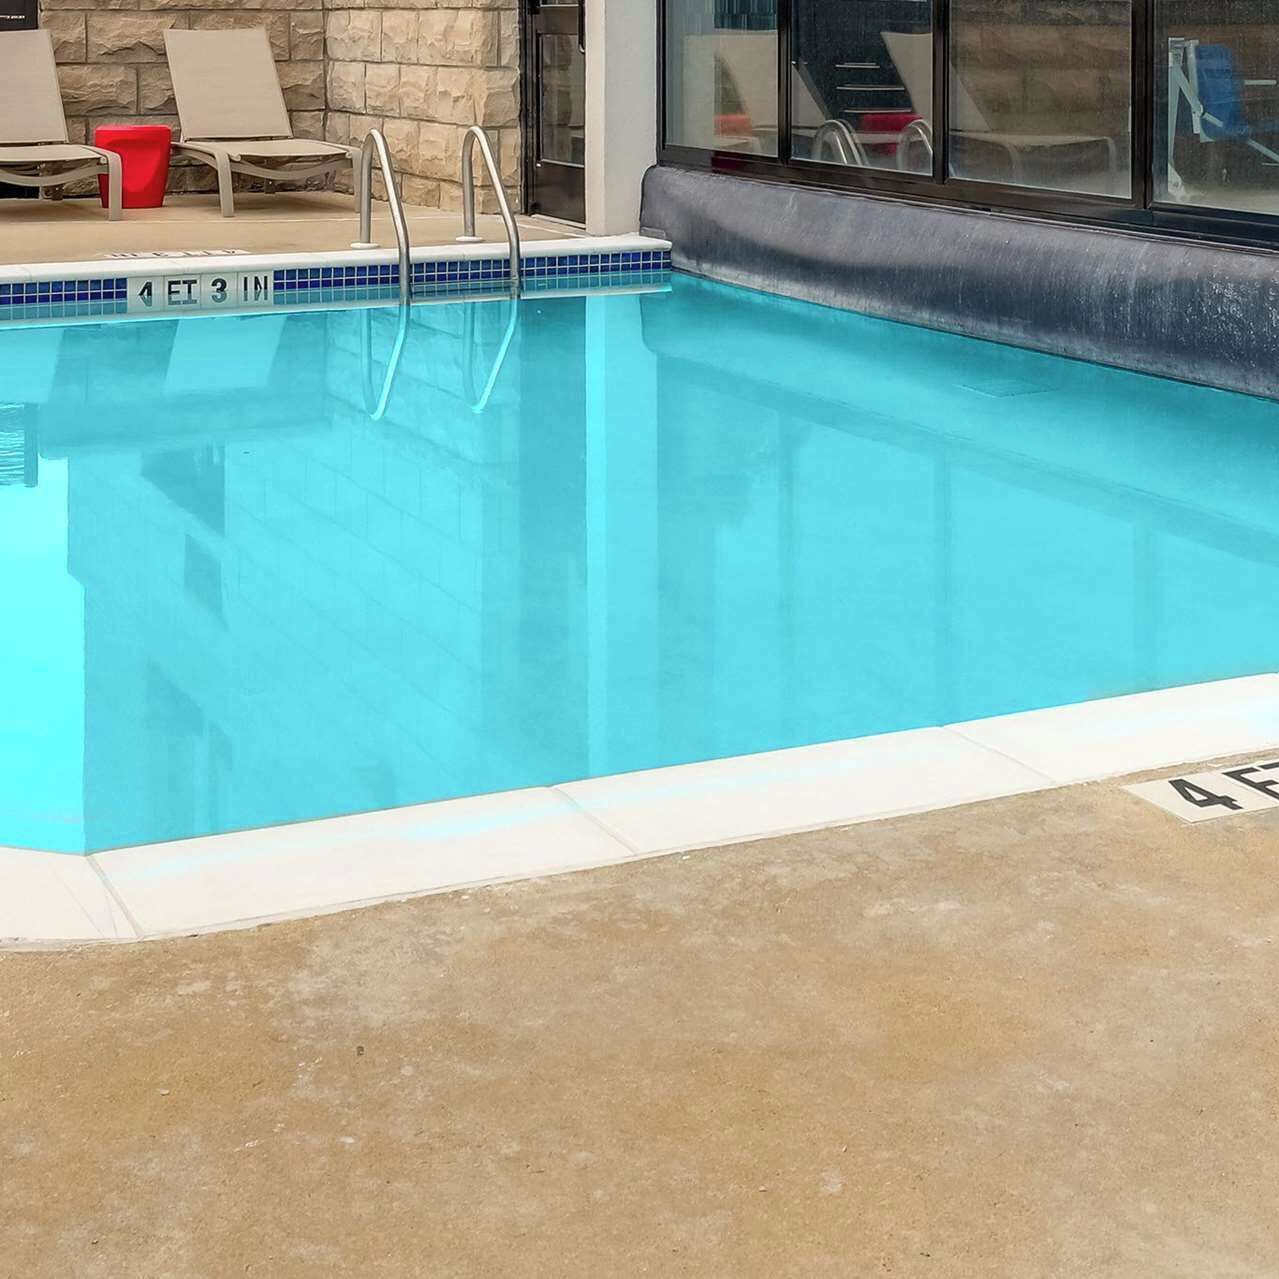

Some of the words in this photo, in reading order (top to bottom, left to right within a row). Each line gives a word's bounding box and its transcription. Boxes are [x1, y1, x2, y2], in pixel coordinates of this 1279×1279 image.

[168, 280, 197, 302] FT
[244, 276, 268, 298] IN
[1167, 778, 1243, 811] 4
